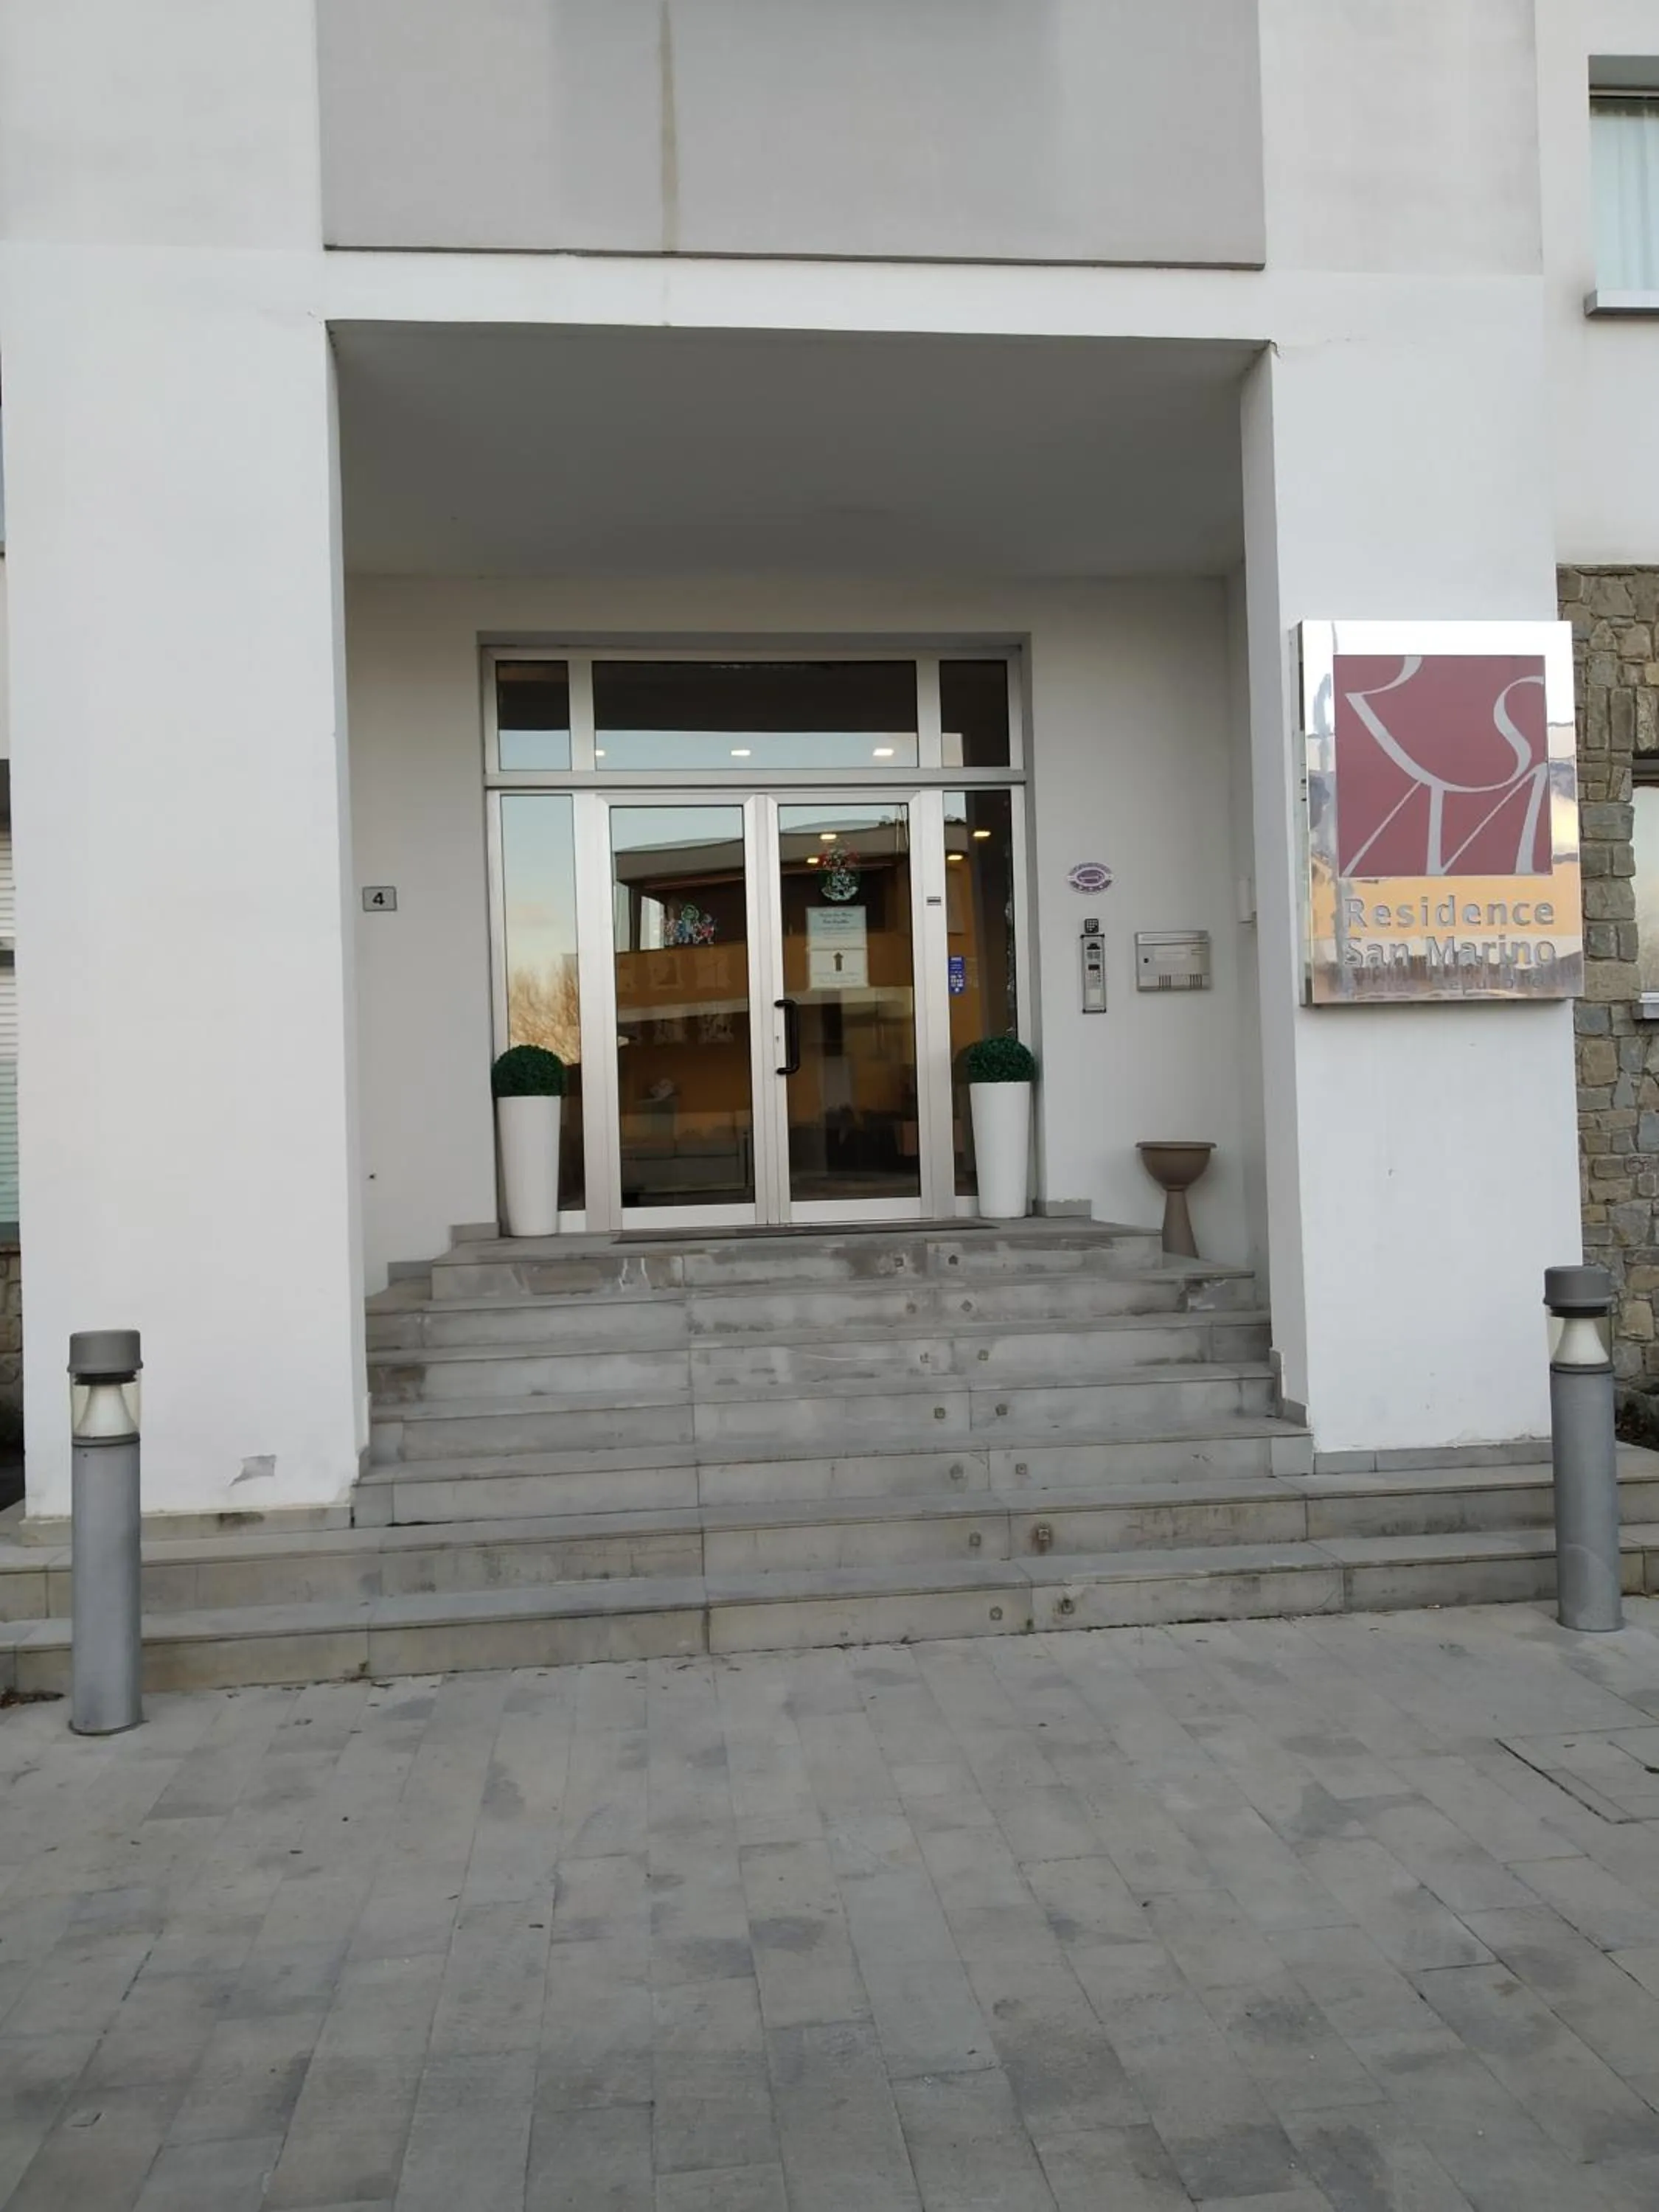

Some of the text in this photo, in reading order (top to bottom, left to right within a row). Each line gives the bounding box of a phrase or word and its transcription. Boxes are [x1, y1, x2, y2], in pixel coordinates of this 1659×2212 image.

[372, 892, 385, 905] 4
[1343, 894, 1555, 928] Residence
[1343, 934, 1557, 967] San Marino
